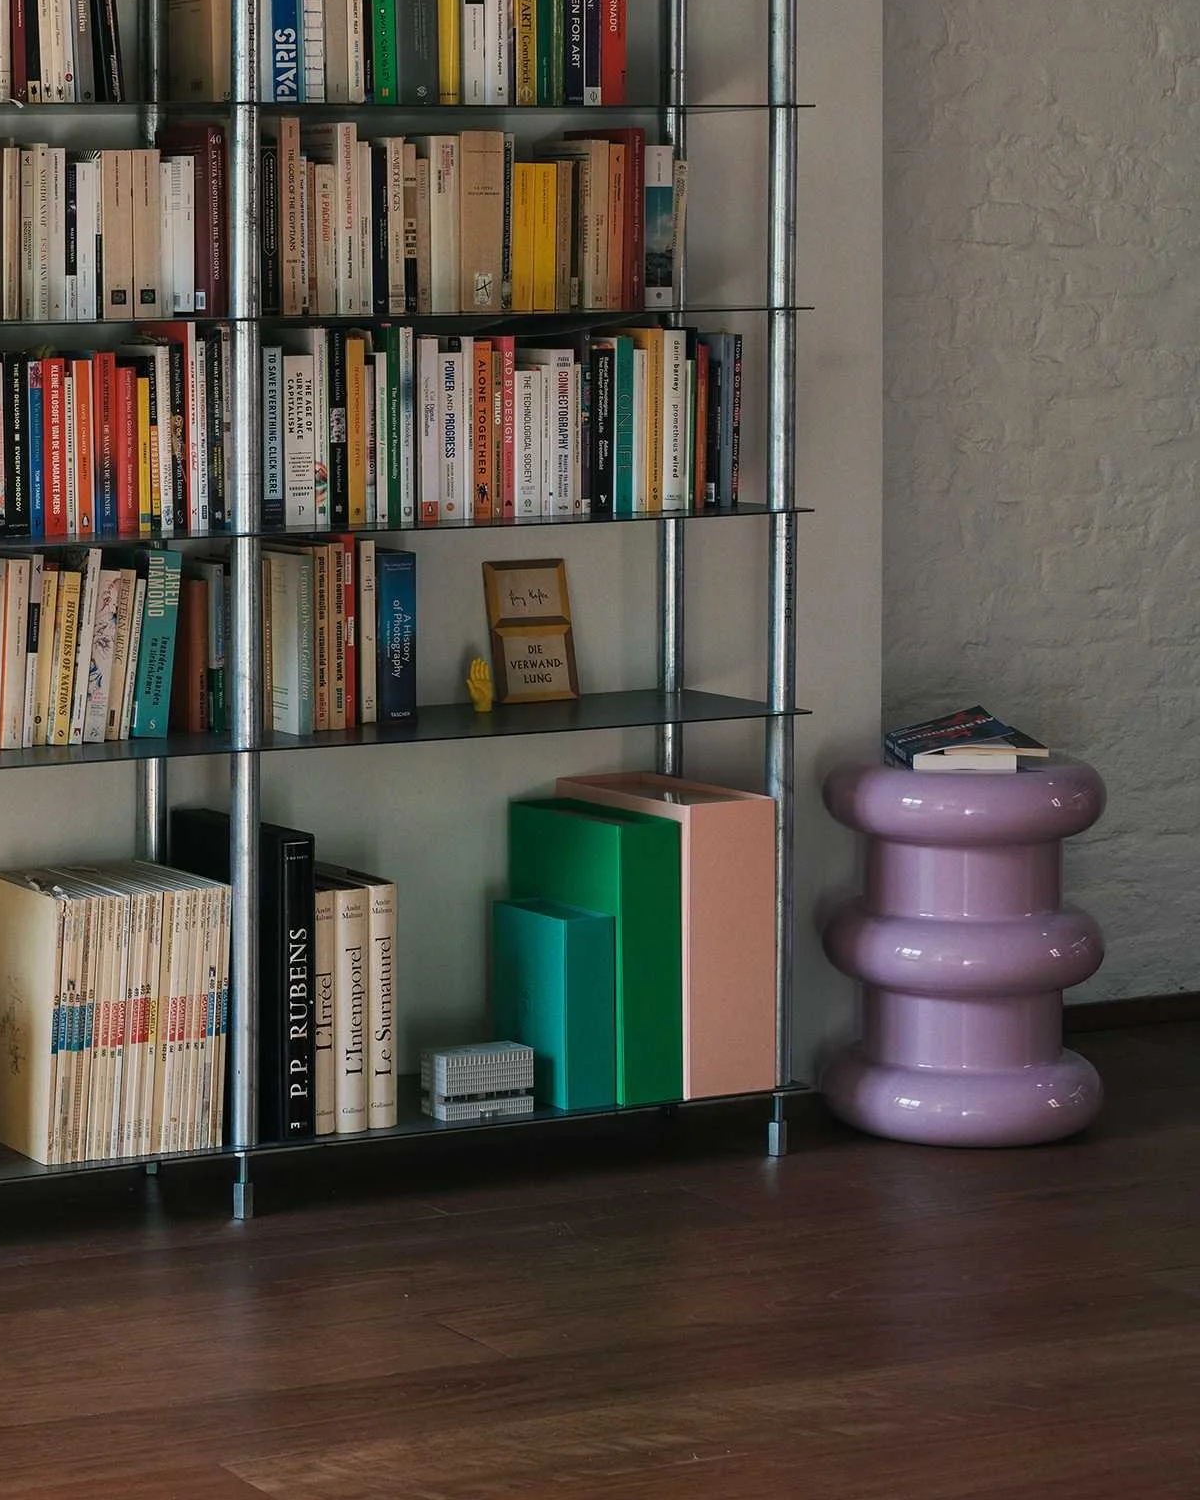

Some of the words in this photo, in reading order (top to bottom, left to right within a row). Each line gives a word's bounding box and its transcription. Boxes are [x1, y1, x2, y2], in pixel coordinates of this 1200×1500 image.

[522, 4, 531, 31] ART
[571, 18, 580, 41] FOR
[275, 28, 297, 101] PARIS
[521, 35, 530, 83] Gombrich
[571, 45, 580, 68] ART
[268, 354, 276, 364] TO
[268, 366, 276, 387] SAVE
[445, 361, 454, 391] POWER
[478, 360, 486, 402] ALONE
[268, 389, 277, 444] EVERYTHING,
[559, 371, 568, 450] CONNECTOGRAPHY
[446, 413, 455, 458] PROGRESS
[478, 408, 487, 474] TOGETHER
[269, 446, 277, 470] CLICK
[269, 473, 277, 493] HERE
[148, 557, 164, 617] DIAMOND
[166, 566, 179, 605] JARED
[394, 600, 401, 611] of
[403, 614, 411, 622] A
[66, 600, 75, 656] HISTORIES
[392, 614, 402, 677] Photography
[402, 625, 411, 662] History
[64, 658, 72, 670] OF
[527, 645, 544, 654] DIE
[59, 672, 70, 716] NATIONS
[524, 676, 552, 684] LUNG
[290, 928, 308, 1039] RUBENS
[375, 937, 392, 1043] Surnaturel
[345, 946, 365, 1075] L'Intemporel
[375, 1050, 392, 1076] Le
